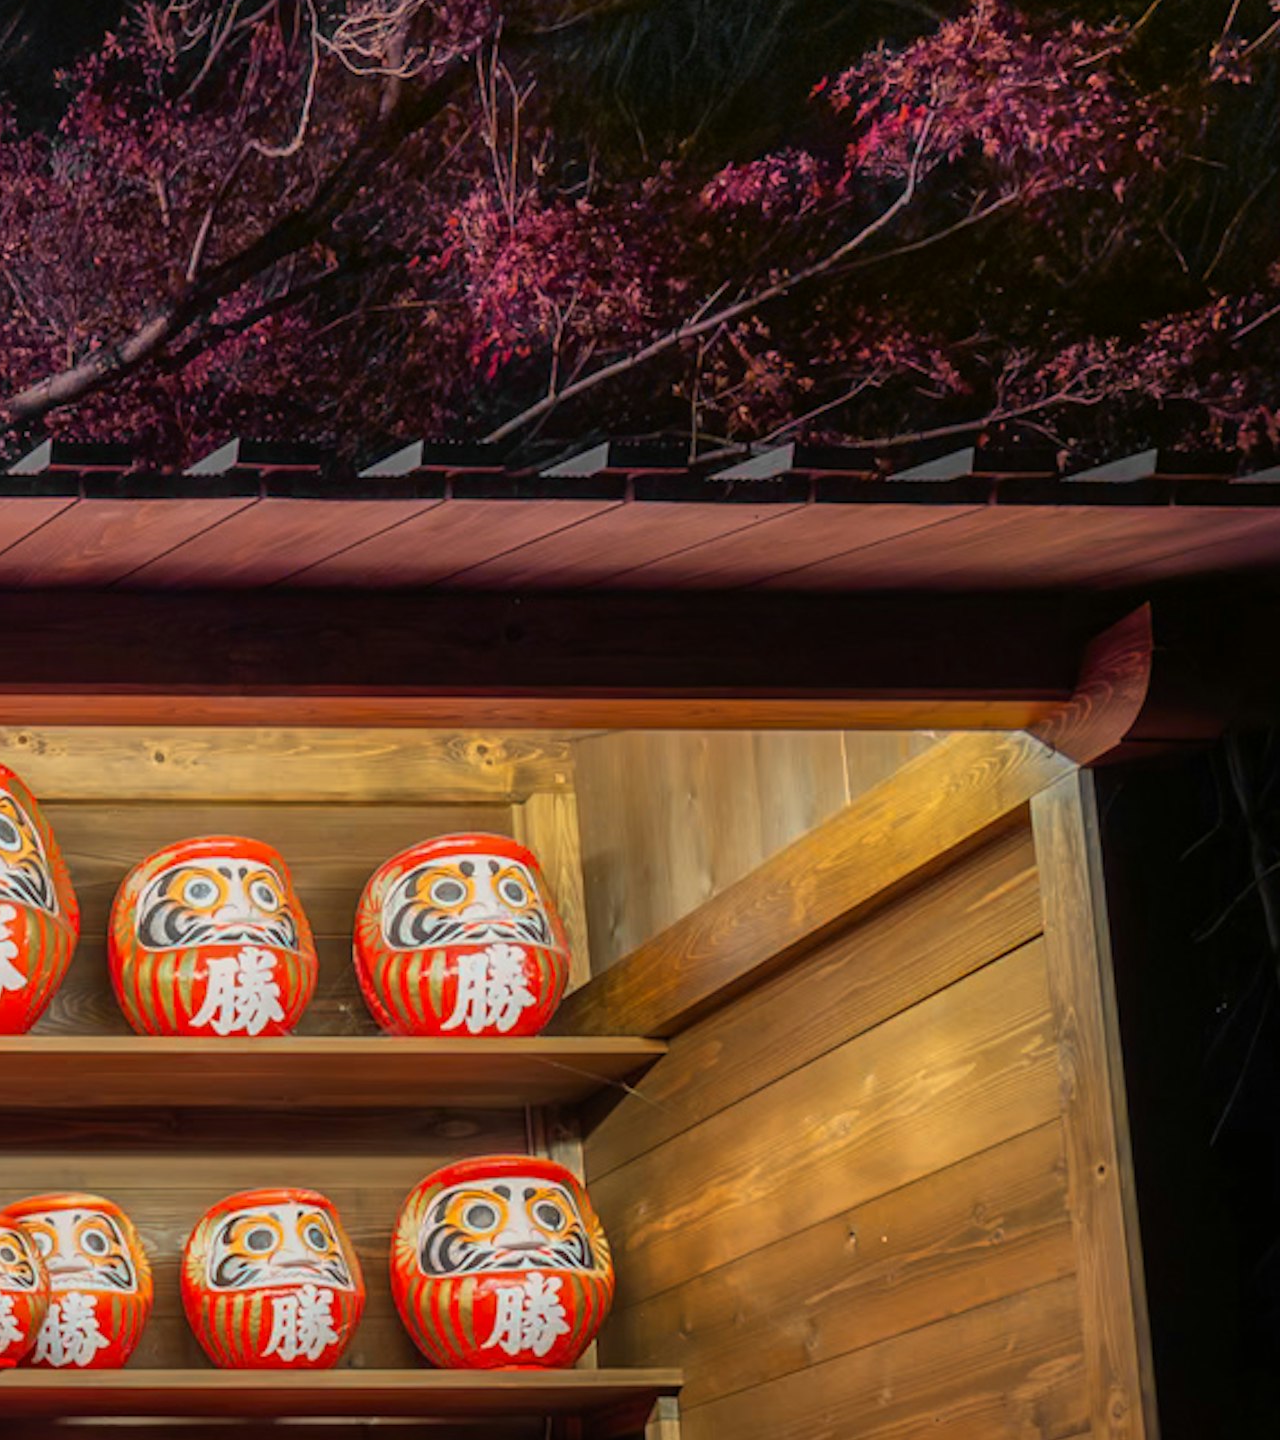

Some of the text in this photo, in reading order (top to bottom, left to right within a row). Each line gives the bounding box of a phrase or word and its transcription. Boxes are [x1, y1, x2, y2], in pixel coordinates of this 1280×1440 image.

[190, 948, 286, 1036] 勝
[441, 942, 537, 1034] 勝
[33, 1291, 111, 1368] 勝
[261, 1284, 337, 1360] 勝
[483, 1272, 572, 1356] 勝
